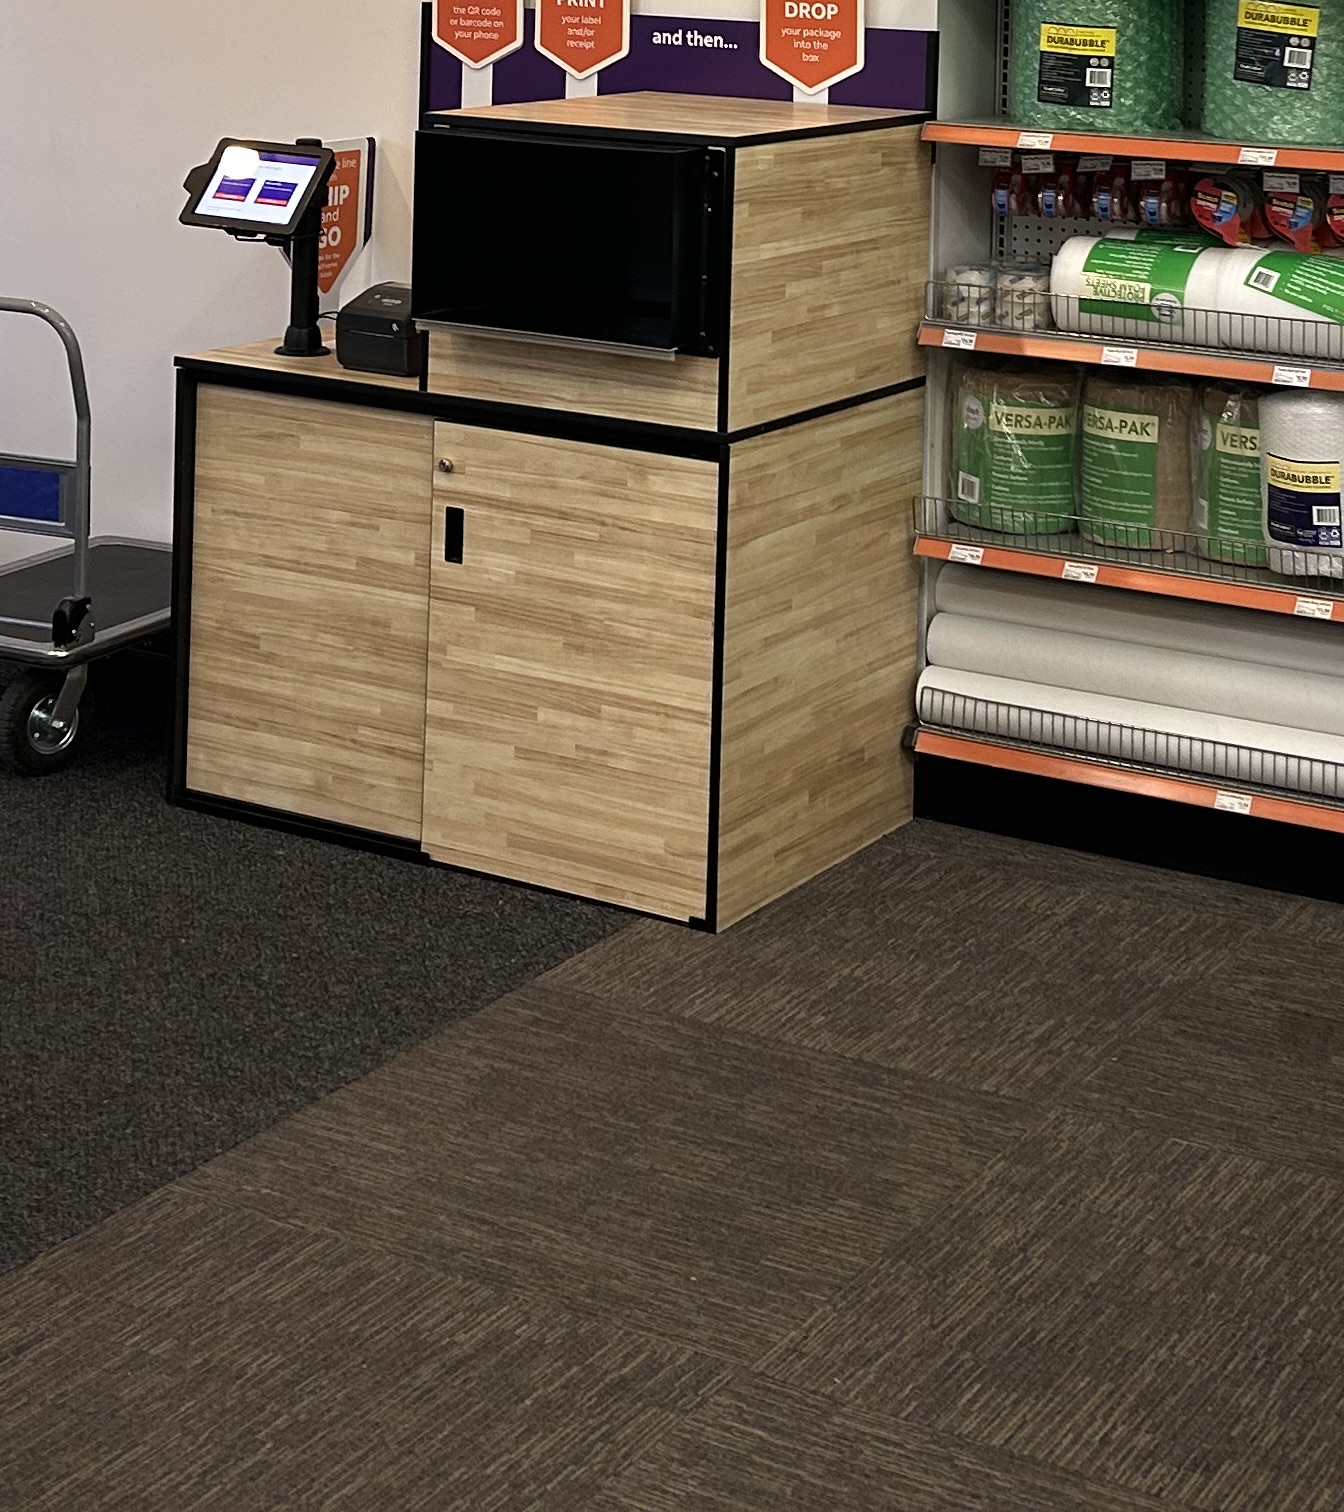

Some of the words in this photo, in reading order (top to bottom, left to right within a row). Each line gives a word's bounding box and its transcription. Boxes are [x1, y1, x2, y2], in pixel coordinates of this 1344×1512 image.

[453, 6, 466, 15] the
[467, 6, 480, 16] QR
[481, 7, 501, 17] code
[785, 1, 838, 21] DROP
[459, 17, 493, 28] barcode
[493, 20, 504, 28] on
[561, 15, 580, 25] your
[581, 15, 602, 25] label
[1244, 10, 1309, 29] DURABUBBLE
[454, 30, 472, 40] your
[473, 30, 499, 41] phone
[567, 27, 596, 37] and/or
[780, 28, 801, 38] your
[802, 27, 842, 40] package
[567, 39, 596, 50] receipt
[652, 29, 683, 47] and
[686, 30, 738, 50] then...
[793, 39, 811, 50] into
[814, 40, 829, 51] the
[1046, 34, 1106, 49] DURABUBBLE
[802, 52, 819, 62] box
[342, 158, 357, 168] line
[321, 208, 339, 223] and
[319, 226, 342, 249] GO
[995, 410, 1072, 430] VERSA-PAK
[1221, 430, 1260, 451] VERS
[1271, 468, 1331, 485] DURABUBBLE
